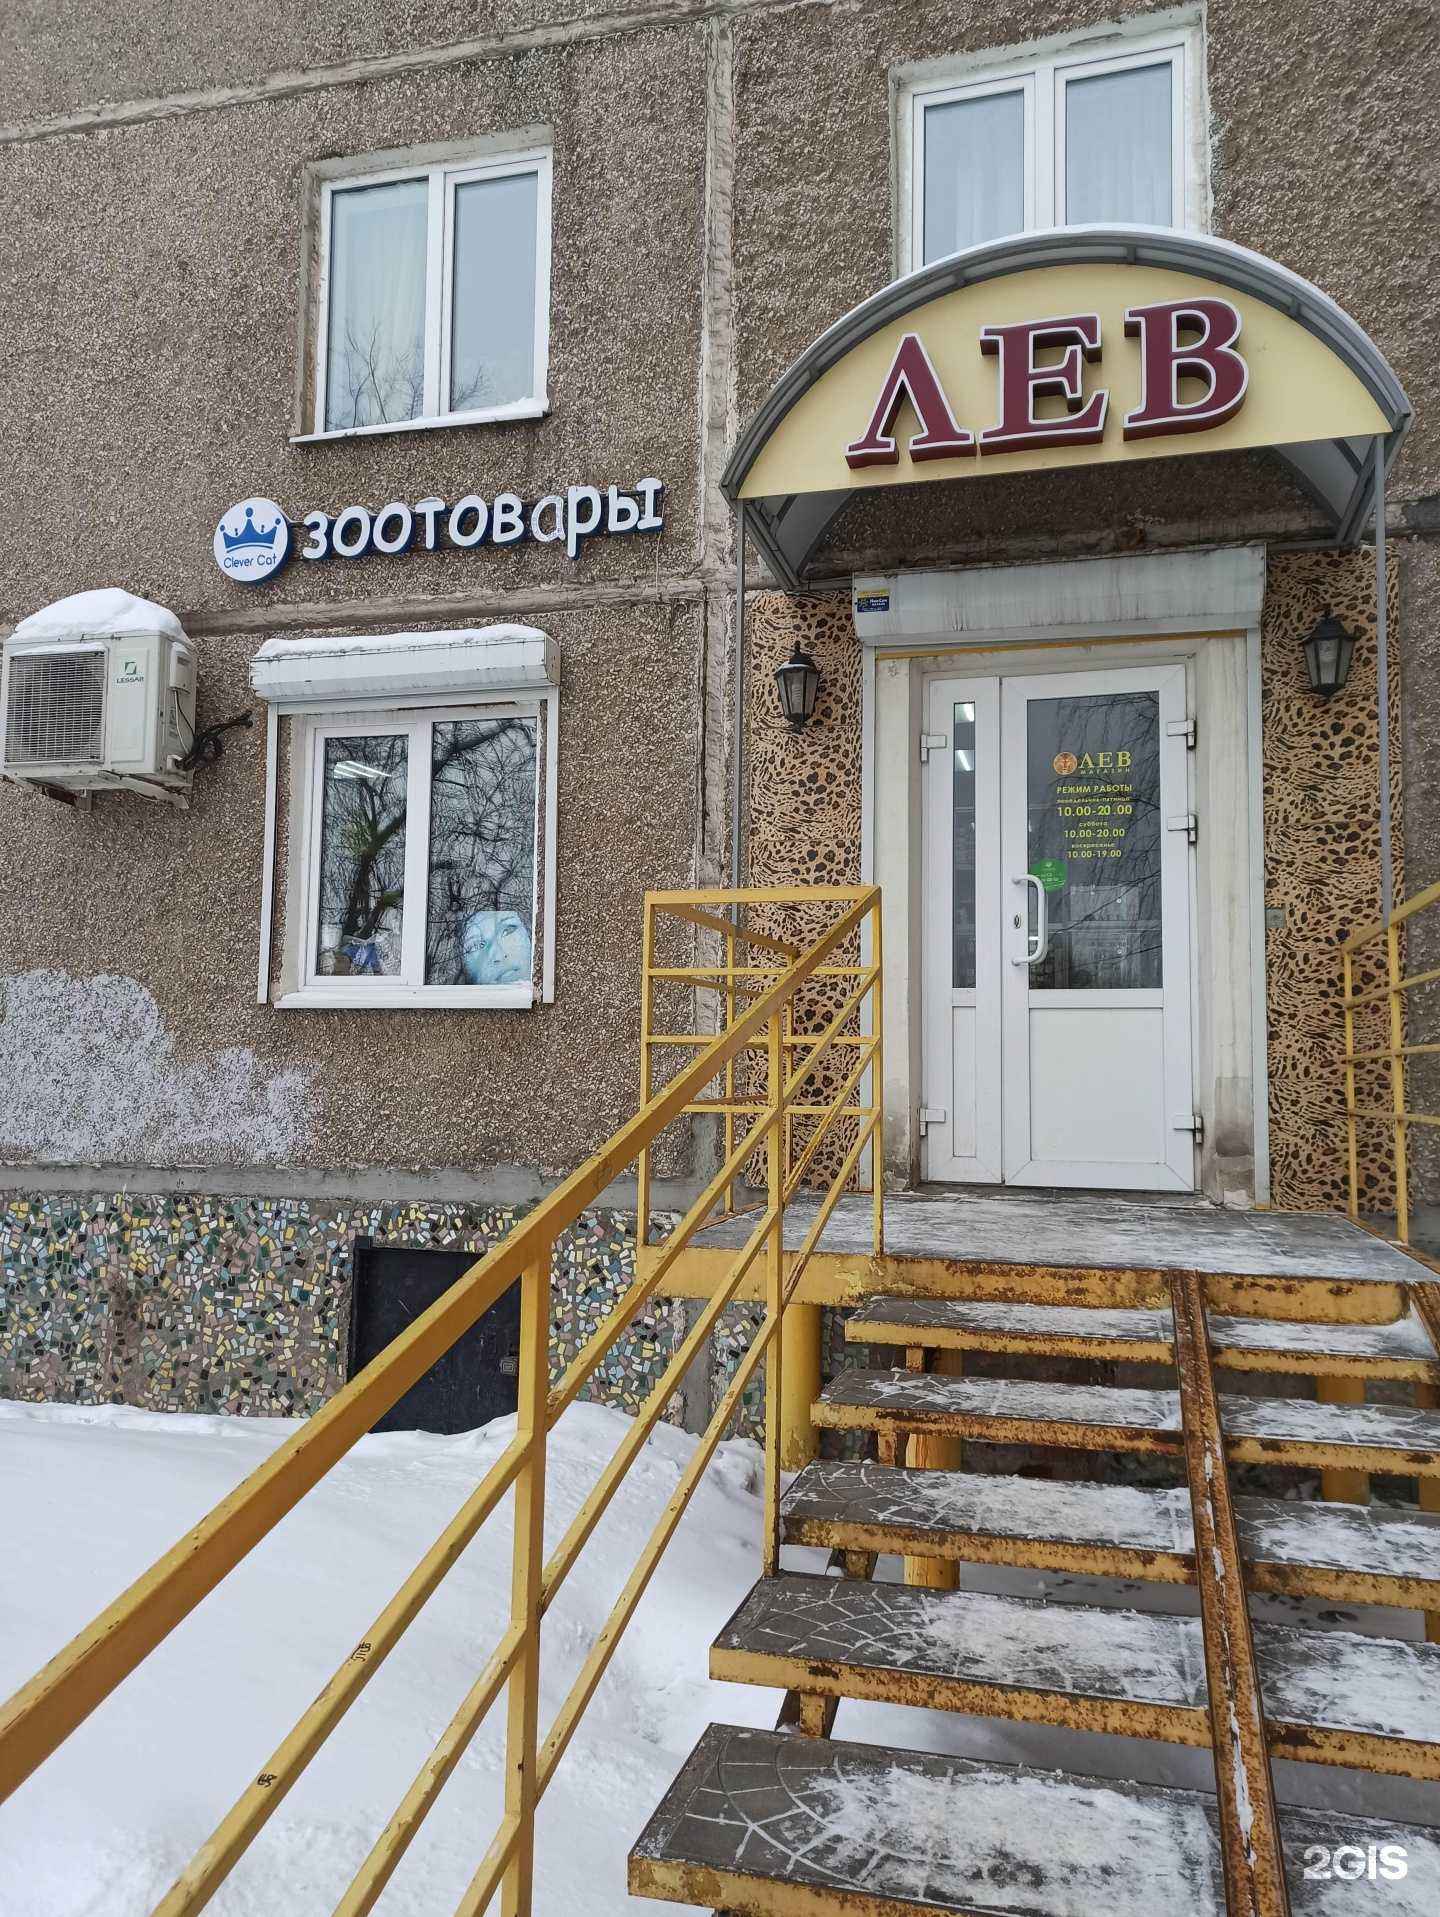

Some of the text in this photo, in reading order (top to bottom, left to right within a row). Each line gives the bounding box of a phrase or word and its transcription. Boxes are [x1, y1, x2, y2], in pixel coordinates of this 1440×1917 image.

[845, 297, 1250, 470] ЛЕВ
[223, 553, 277, 569] Clever Cat
[1078, 751, 1132, 768] ЛЕВ
[1056, 784, 1132, 794] РЕЖИМ РАБОТЫ
[1064, 828, 1125, 838] 10.00-20.00
